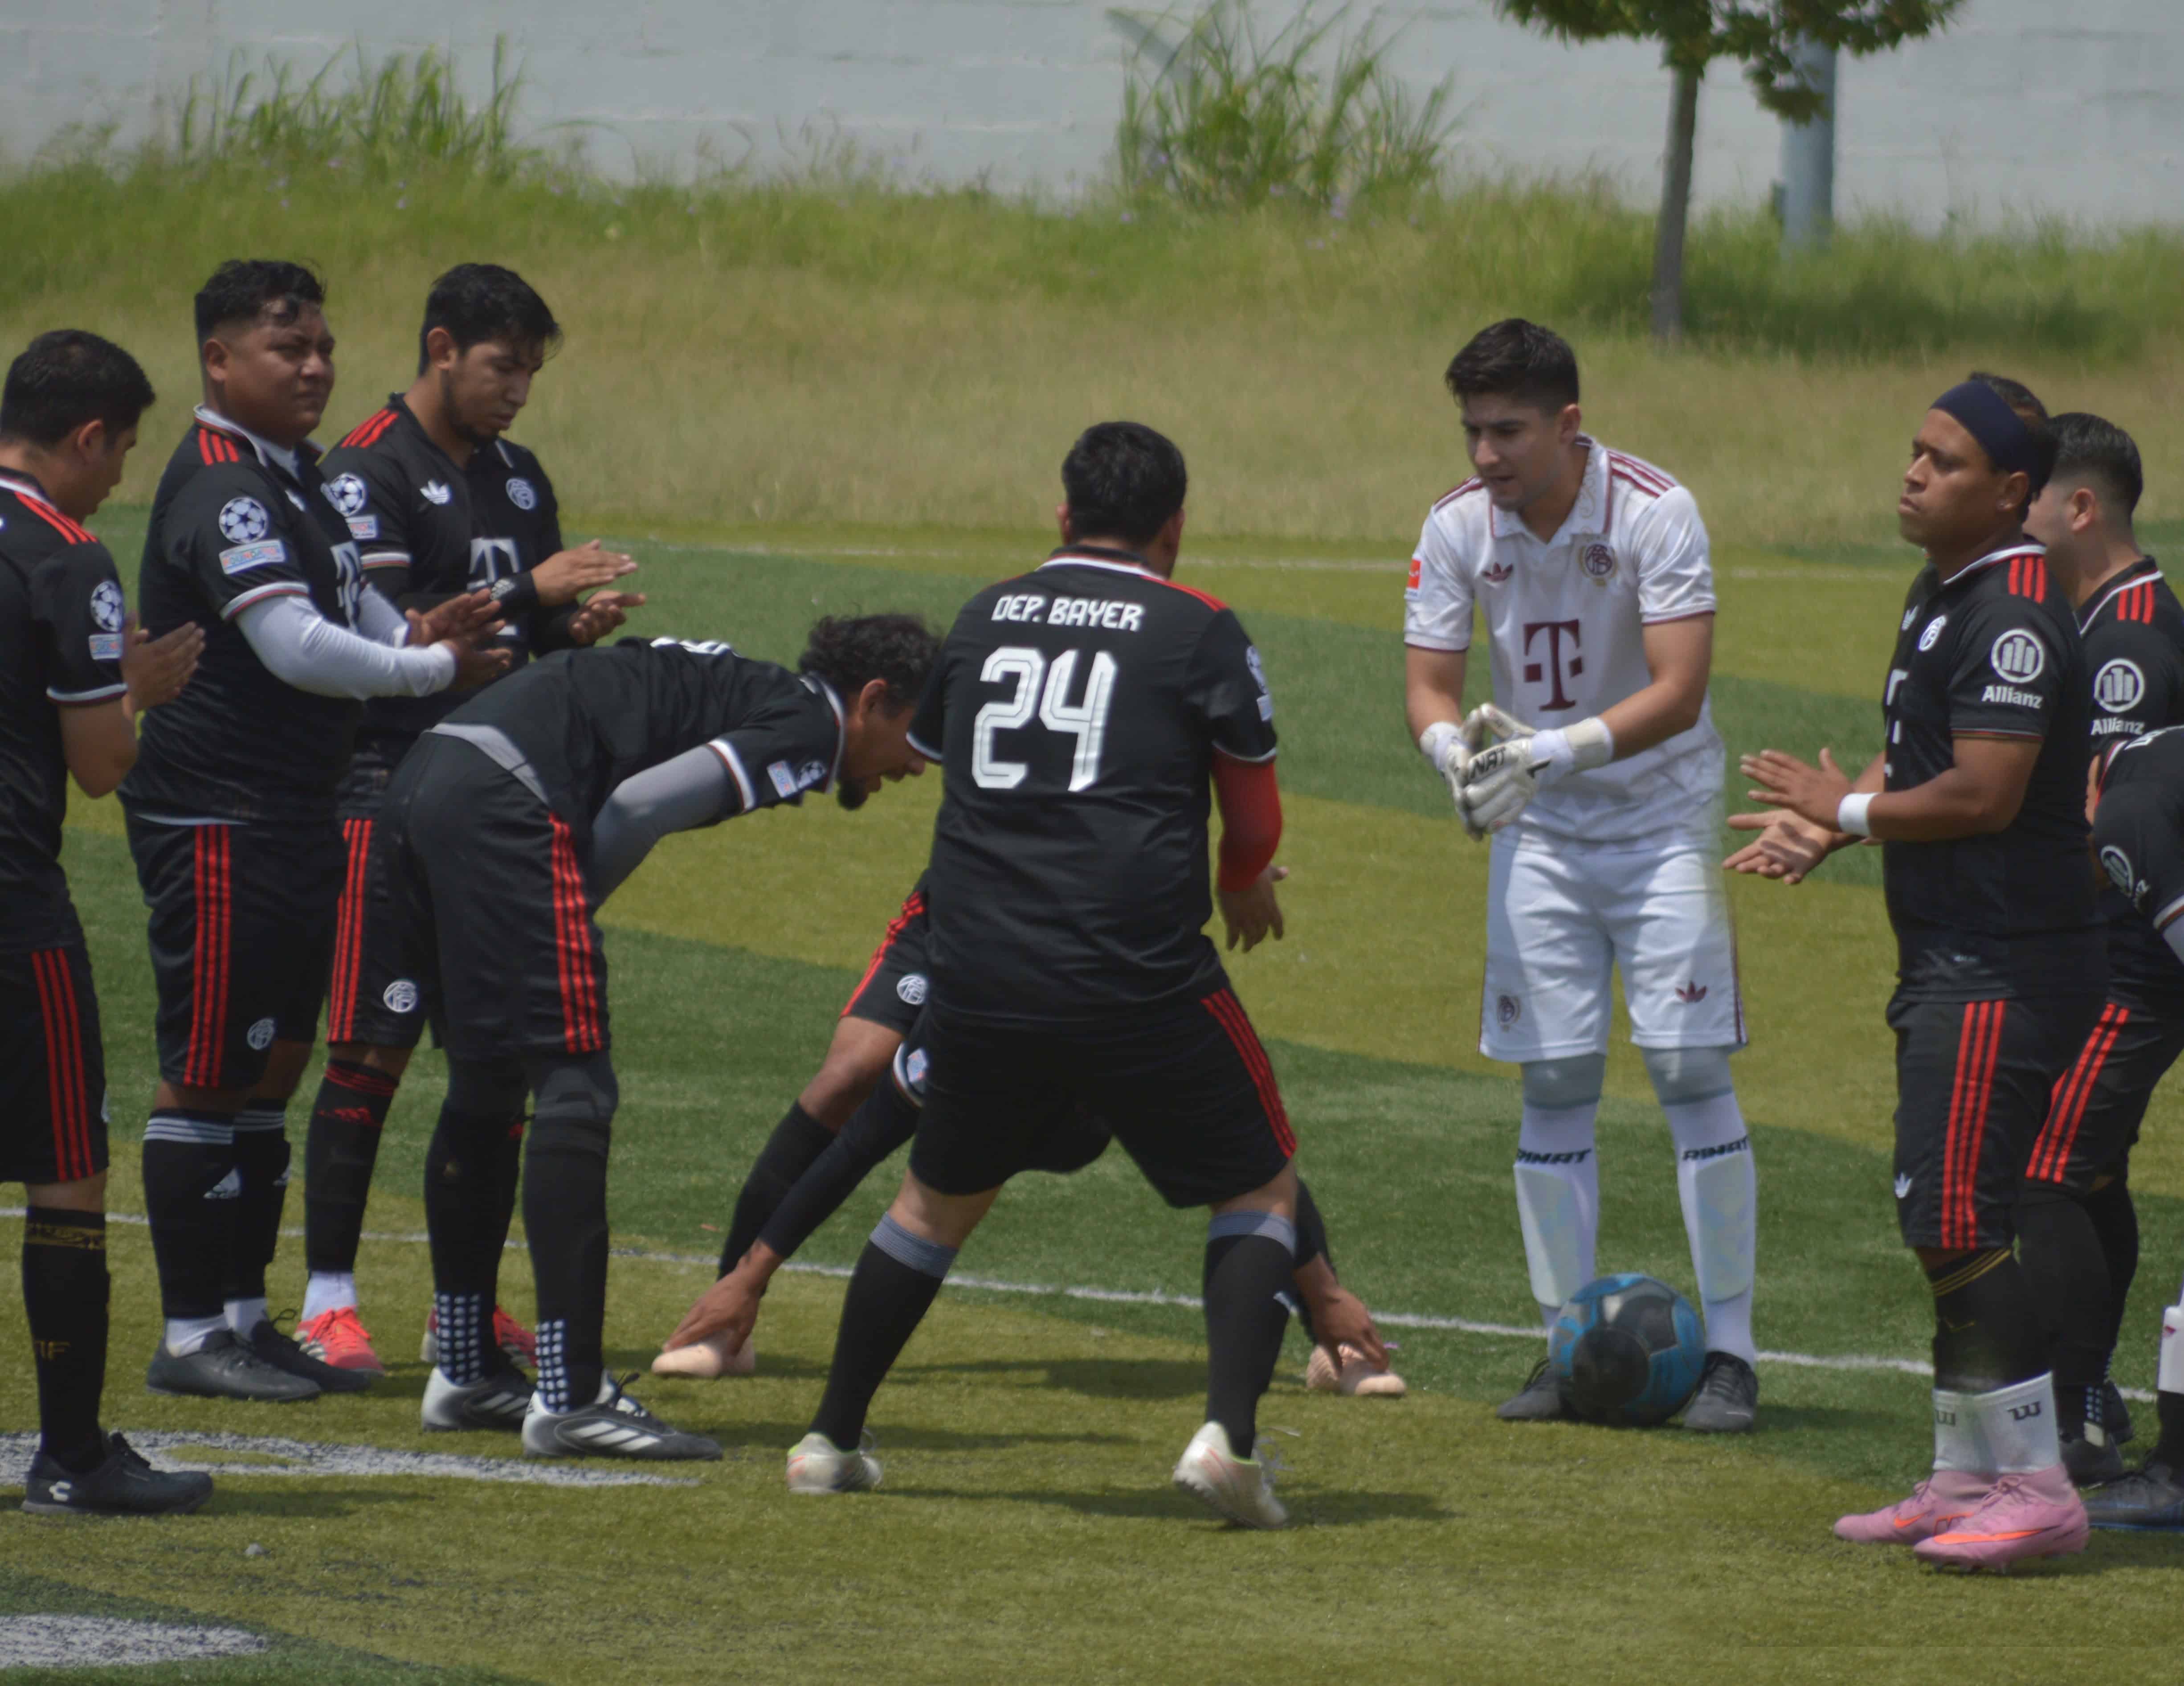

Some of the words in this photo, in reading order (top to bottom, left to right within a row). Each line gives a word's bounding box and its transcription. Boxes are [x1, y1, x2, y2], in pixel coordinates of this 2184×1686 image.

[991, 594, 1044, 622] DEP.
[1047, 596, 1143, 631] BAYER
[1523, 618, 1583, 711] T
[1981, 684, 2044, 709] Allianz
[971, 646, 1116, 792] 24
[2090, 717, 2145, 735] Allianz
